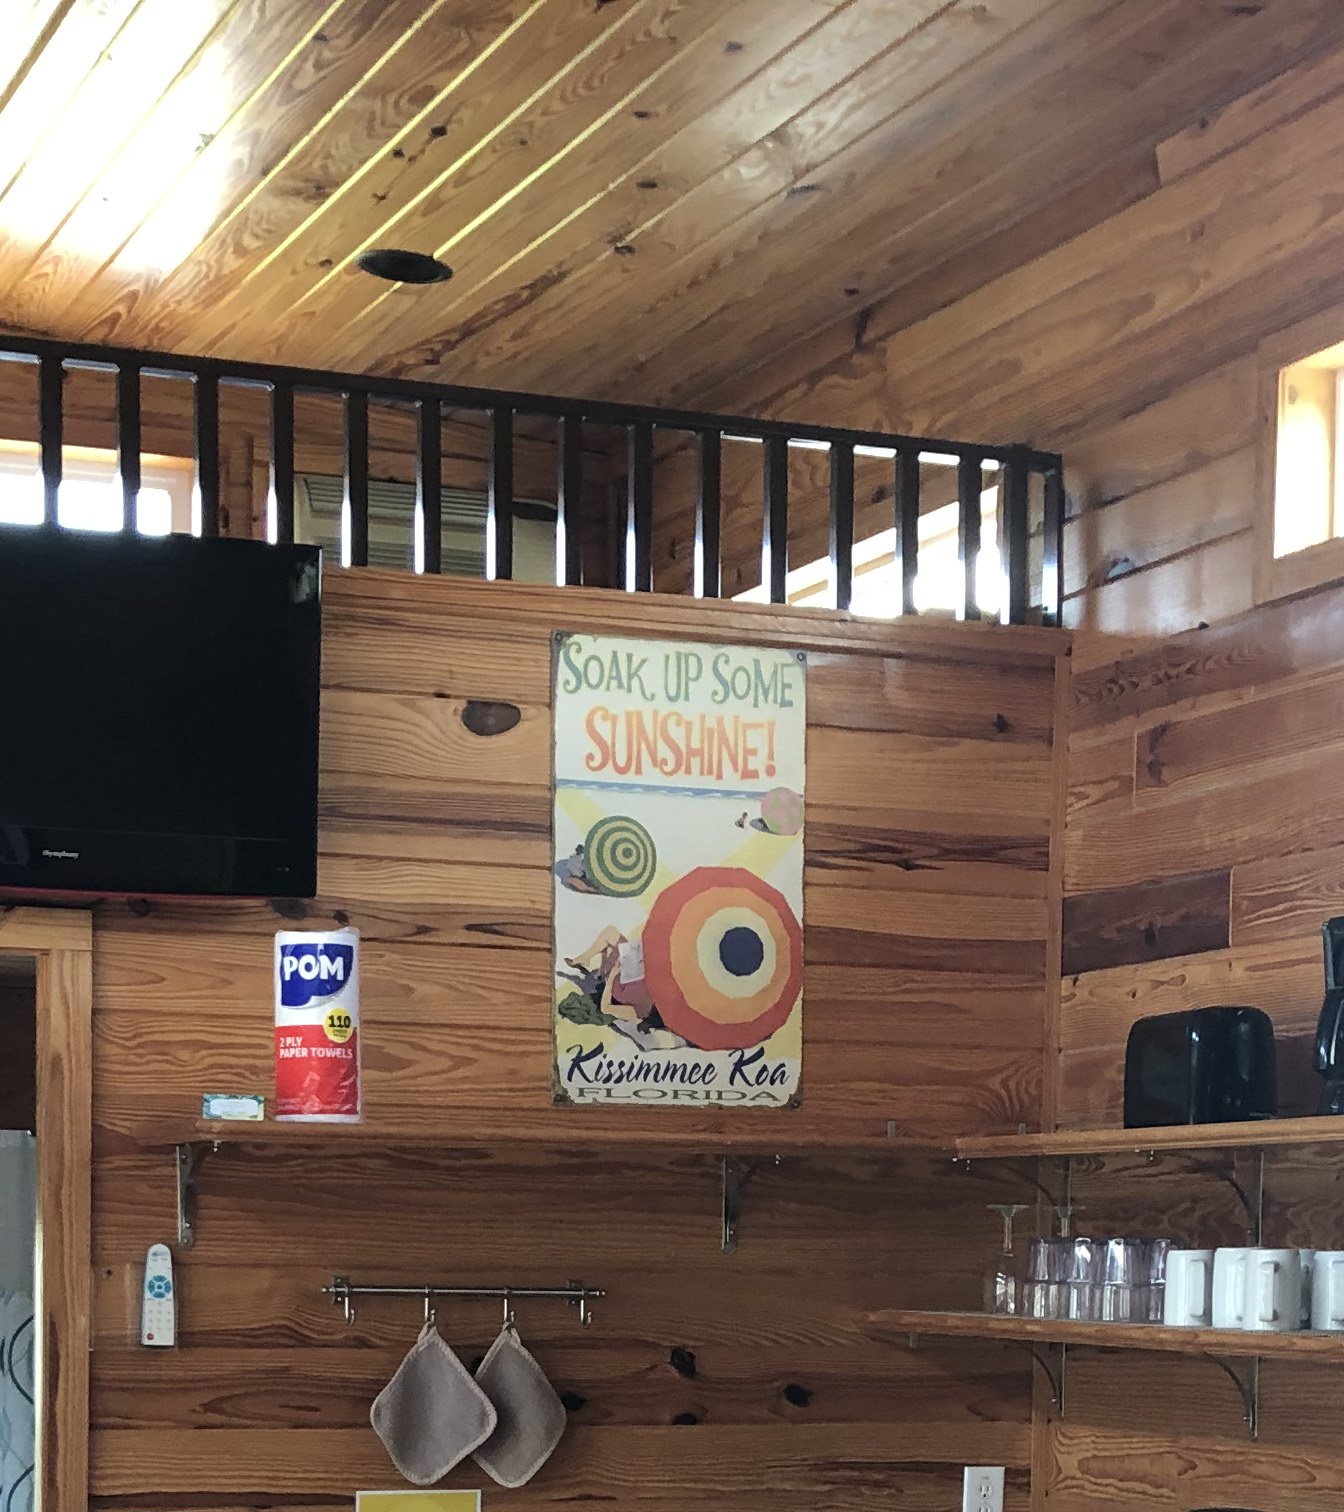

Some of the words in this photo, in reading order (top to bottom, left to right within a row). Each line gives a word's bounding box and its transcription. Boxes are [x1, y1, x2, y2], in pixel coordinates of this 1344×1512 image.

[562, 641, 656, 701] SOAK
[664, 650, 703, 702] UP
[711, 652, 795, 708] SOME
[585, 706, 776, 780] SUNSHINE!
[283, 954, 344, 981] POM
[328, 1014, 351, 1029] 110
[279, 1037, 285, 1047] 2
[286, 1036, 303, 1047] PLY
[279, 1047, 308, 1058] PAPER
[310, 1048, 353, 1059] TOWELS
[566, 1042, 718, 1085] Kissimmee
[728, 1046, 790, 1087] Koa
[577, 1087, 781, 1102] FLORIDA
